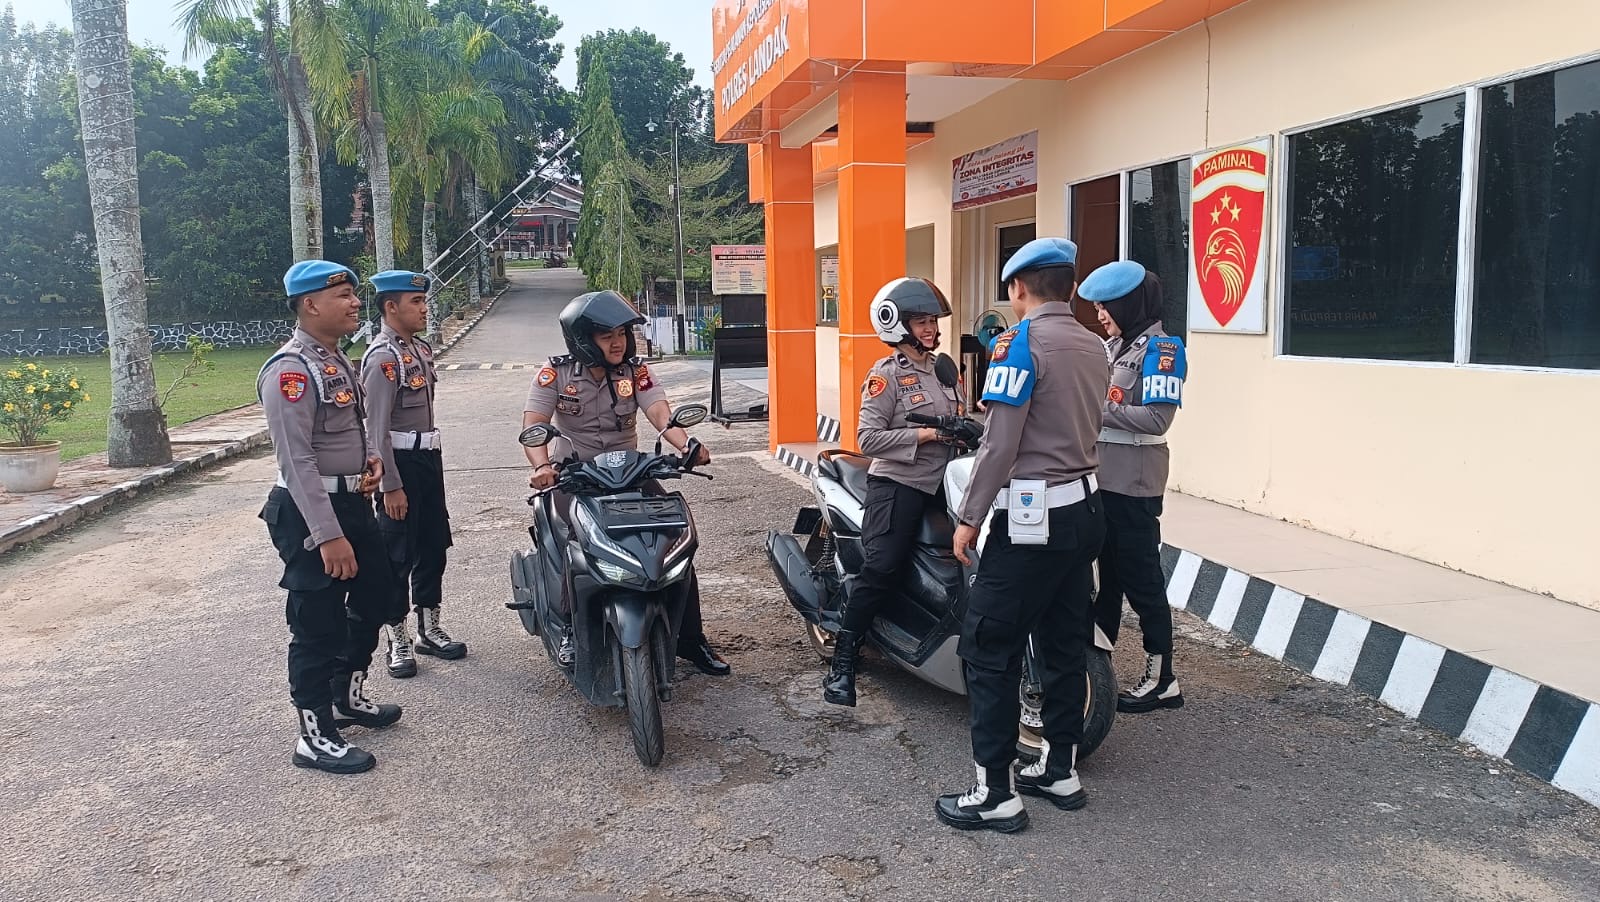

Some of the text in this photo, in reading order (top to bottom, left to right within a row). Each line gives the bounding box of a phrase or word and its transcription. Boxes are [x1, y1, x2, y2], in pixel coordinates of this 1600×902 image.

[722, 62, 747, 115] POLRES
[749, 14, 790, 87] LANDAK
[959, 167, 981, 179] ZONA
[982, 151, 1034, 173] INTEGRITAS
[1203, 152, 1255, 177] PAMINAL
[901, 384, 923, 394] PAULA
[982, 366, 1029, 398] ROV
